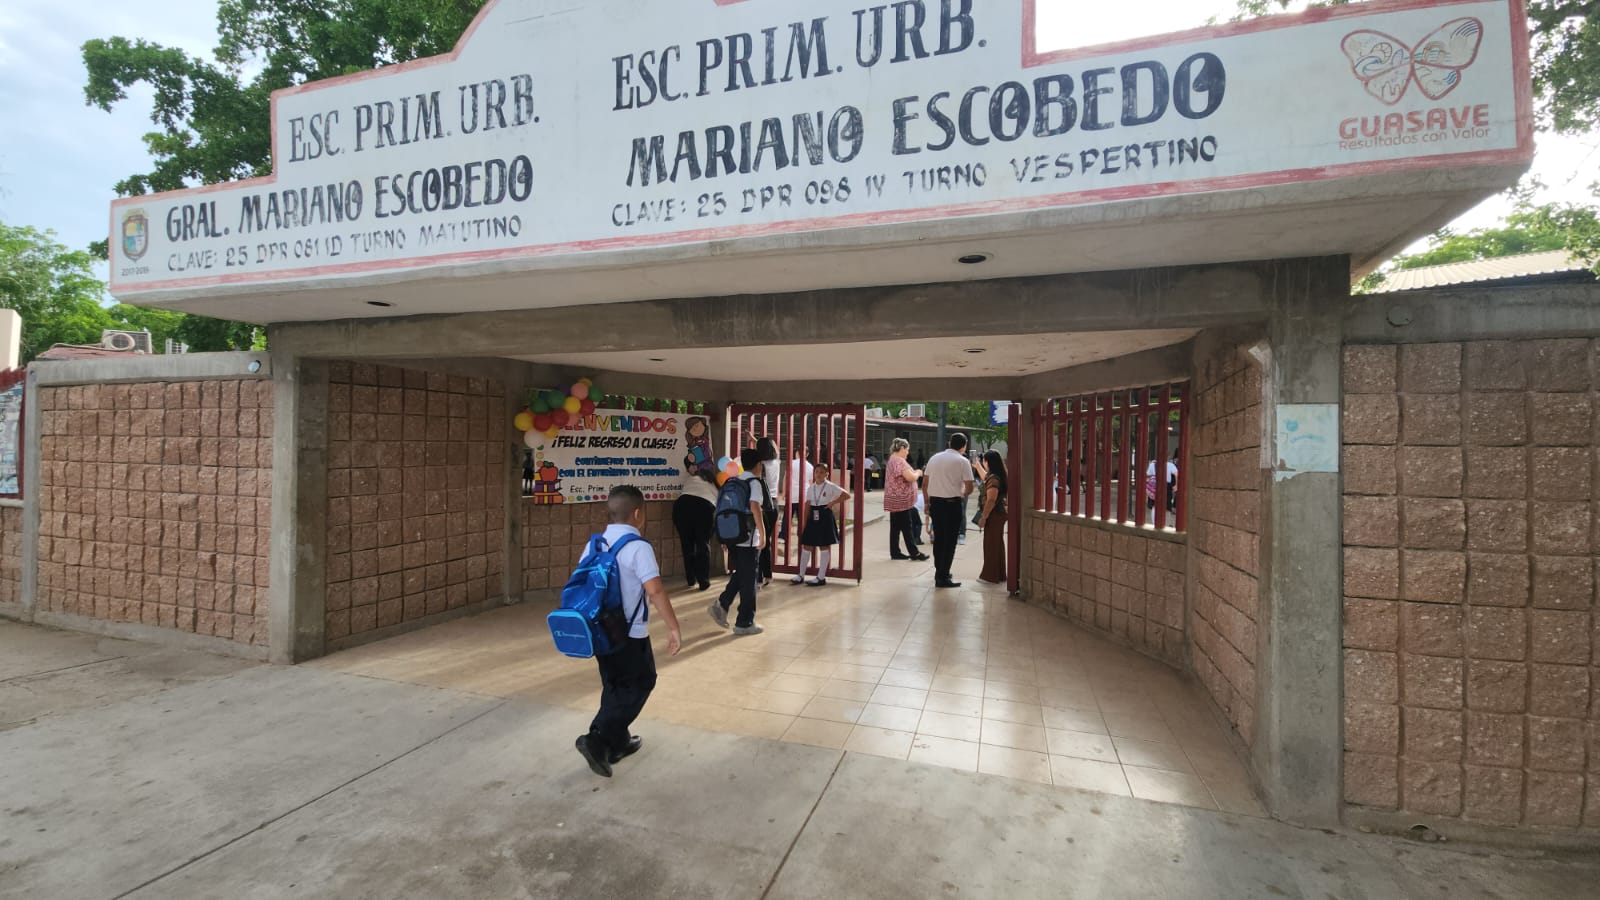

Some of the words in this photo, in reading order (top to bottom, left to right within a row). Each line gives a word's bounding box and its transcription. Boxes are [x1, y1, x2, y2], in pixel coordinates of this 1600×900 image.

[611, 44, 689, 111] ESC.
[695, 16, 843, 96] PRIM.
[852, 0, 988, 68] URB.
[288, 110, 345, 163] ESC.
[353, 90, 452, 152] PRIM.
[458, 73, 540, 135] URB.
[626, 105, 864, 187] MARIANO
[892, 52, 1226, 155] ESCOBEDO
[1338, 103, 1489, 140] GUASAVE
[1338, 135, 1418, 151] Resultados
[1422, 131, 1447, 143] con
[166, 202, 230, 243] GRAL.
[238, 180, 363, 234] MARIANO
[374, 154, 534, 218] ESCOBEDO
[611, 197, 687, 227] CLAVE:
[697, 191, 727, 218] 25
[740, 183, 792, 213] DPR
[902, 162, 988, 194] TURNO
[1009, 135, 1218, 184] VESPERTINO
[226, 245, 249, 267] 25
[350, 228, 406, 253] TURNO
[418, 215, 522, 247] MATUTINO
[588, 436, 632, 448] REGRESO
[632, 437, 639, 448] A
